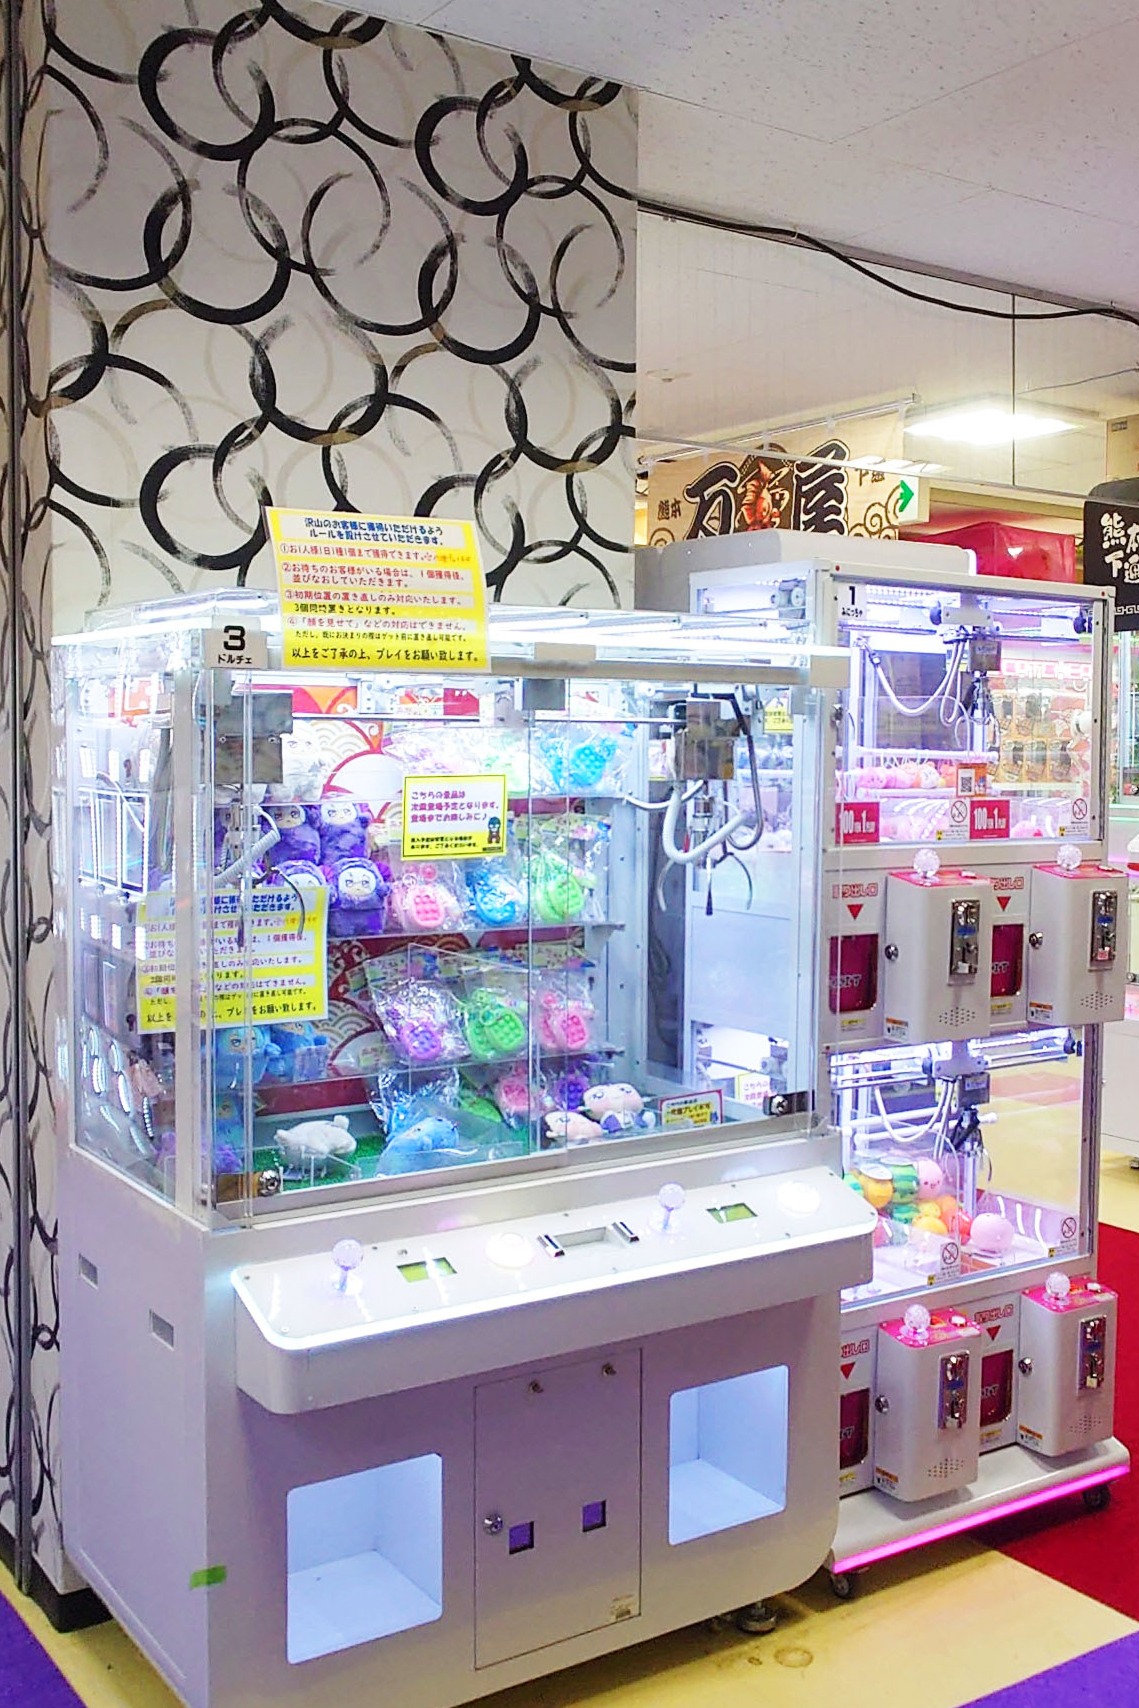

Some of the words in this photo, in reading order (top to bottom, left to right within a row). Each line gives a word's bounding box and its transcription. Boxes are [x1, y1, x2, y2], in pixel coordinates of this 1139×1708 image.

[849, 586, 856, 606] 1
[223, 625, 246, 651] 3
[217, 653, 253, 665] ドルチェ
